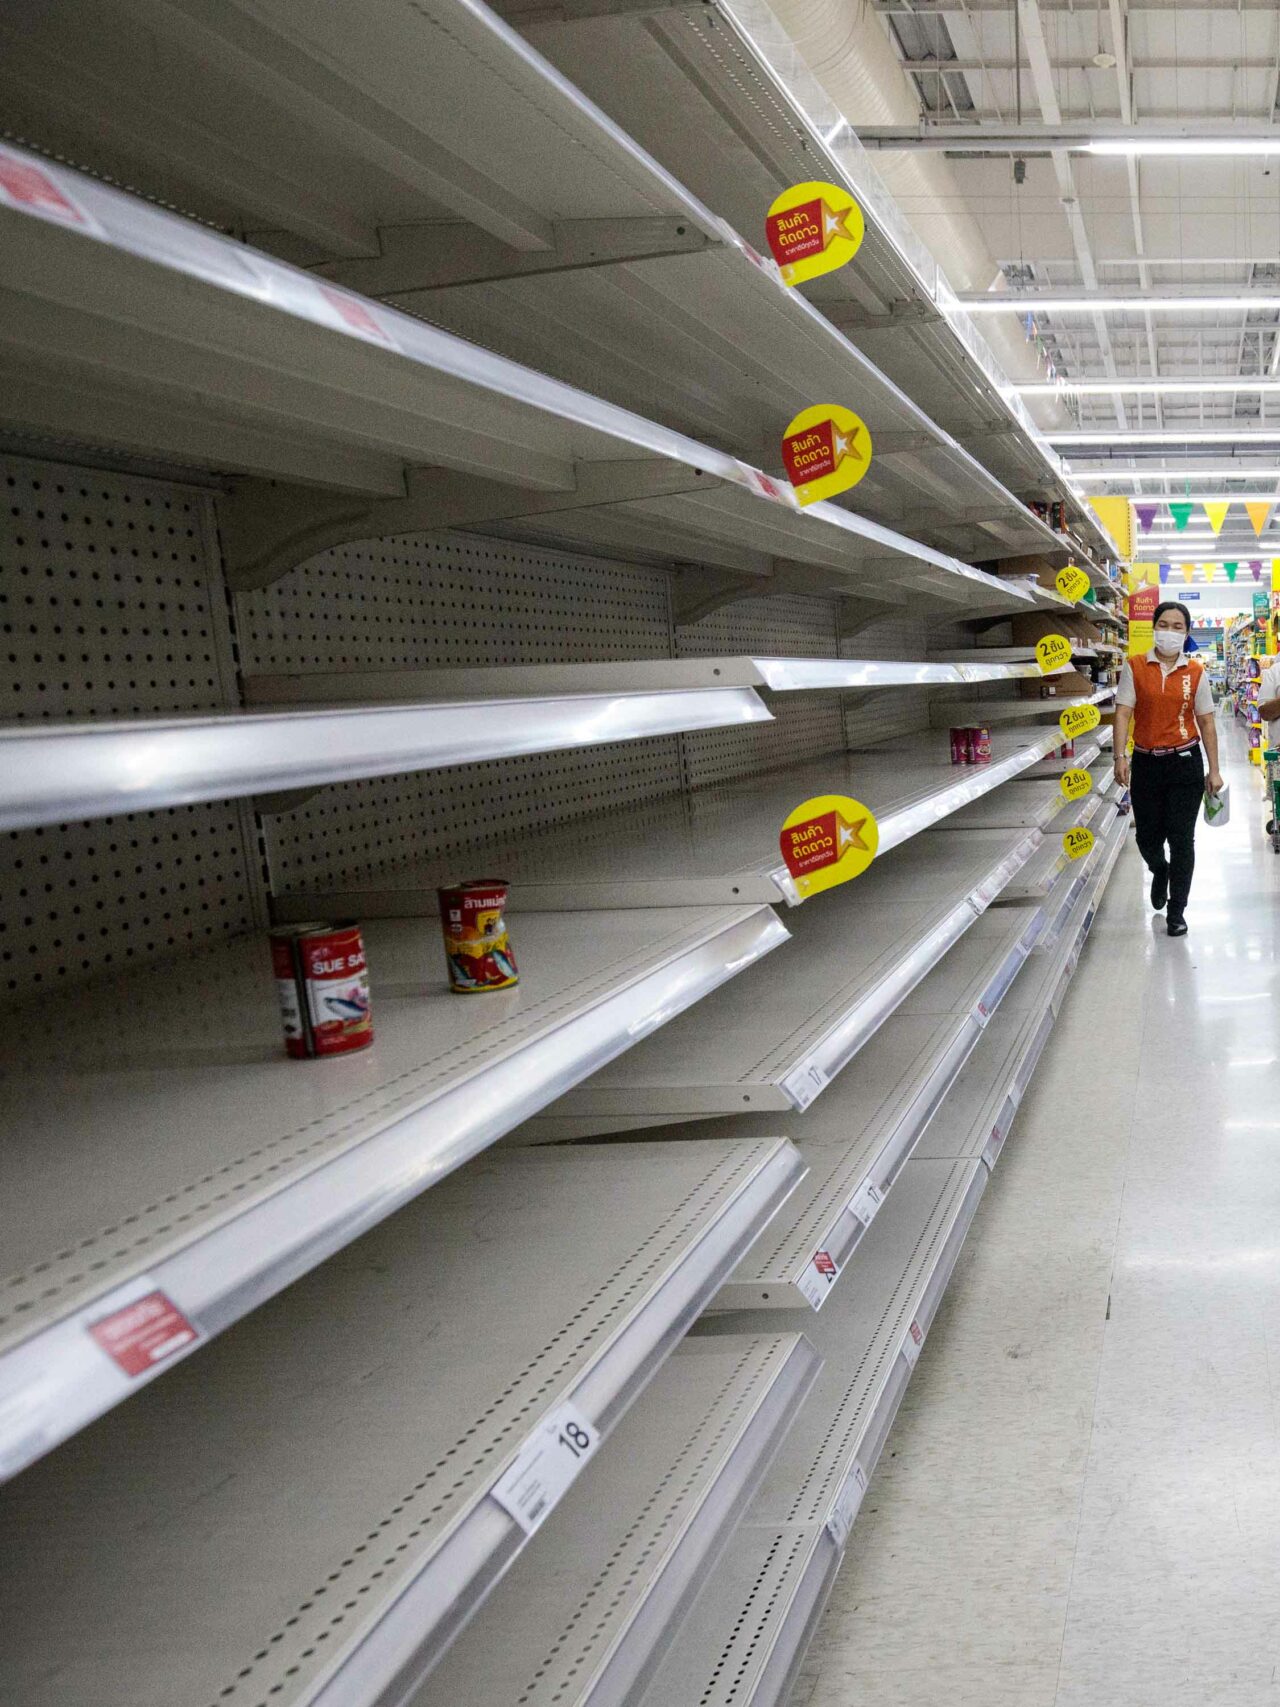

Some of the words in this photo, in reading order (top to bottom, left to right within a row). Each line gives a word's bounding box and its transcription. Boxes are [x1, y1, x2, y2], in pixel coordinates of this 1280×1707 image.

[776, 212, 810, 232] สินค้า
[778, 225, 819, 246] ติดดาว
[791, 434, 822, 453] สินค้า
[793, 446, 830, 467] ติดดาว
[1039, 642, 1050, 656] 2
[1182, 674, 1191, 700] TONG
[1063, 713, 1072, 726] 2
[1064, 775, 1073, 787] 2
[790, 825, 824, 844] สินค้า
[1066, 834, 1076, 846] 2
[792, 836, 833, 858] ติดดาว
[311, 956, 345, 975] SUE
[808, 1065, 822, 1086] 17
[867, 1185, 880, 1204] 17
[559, 1421, 590, 1459] 18
